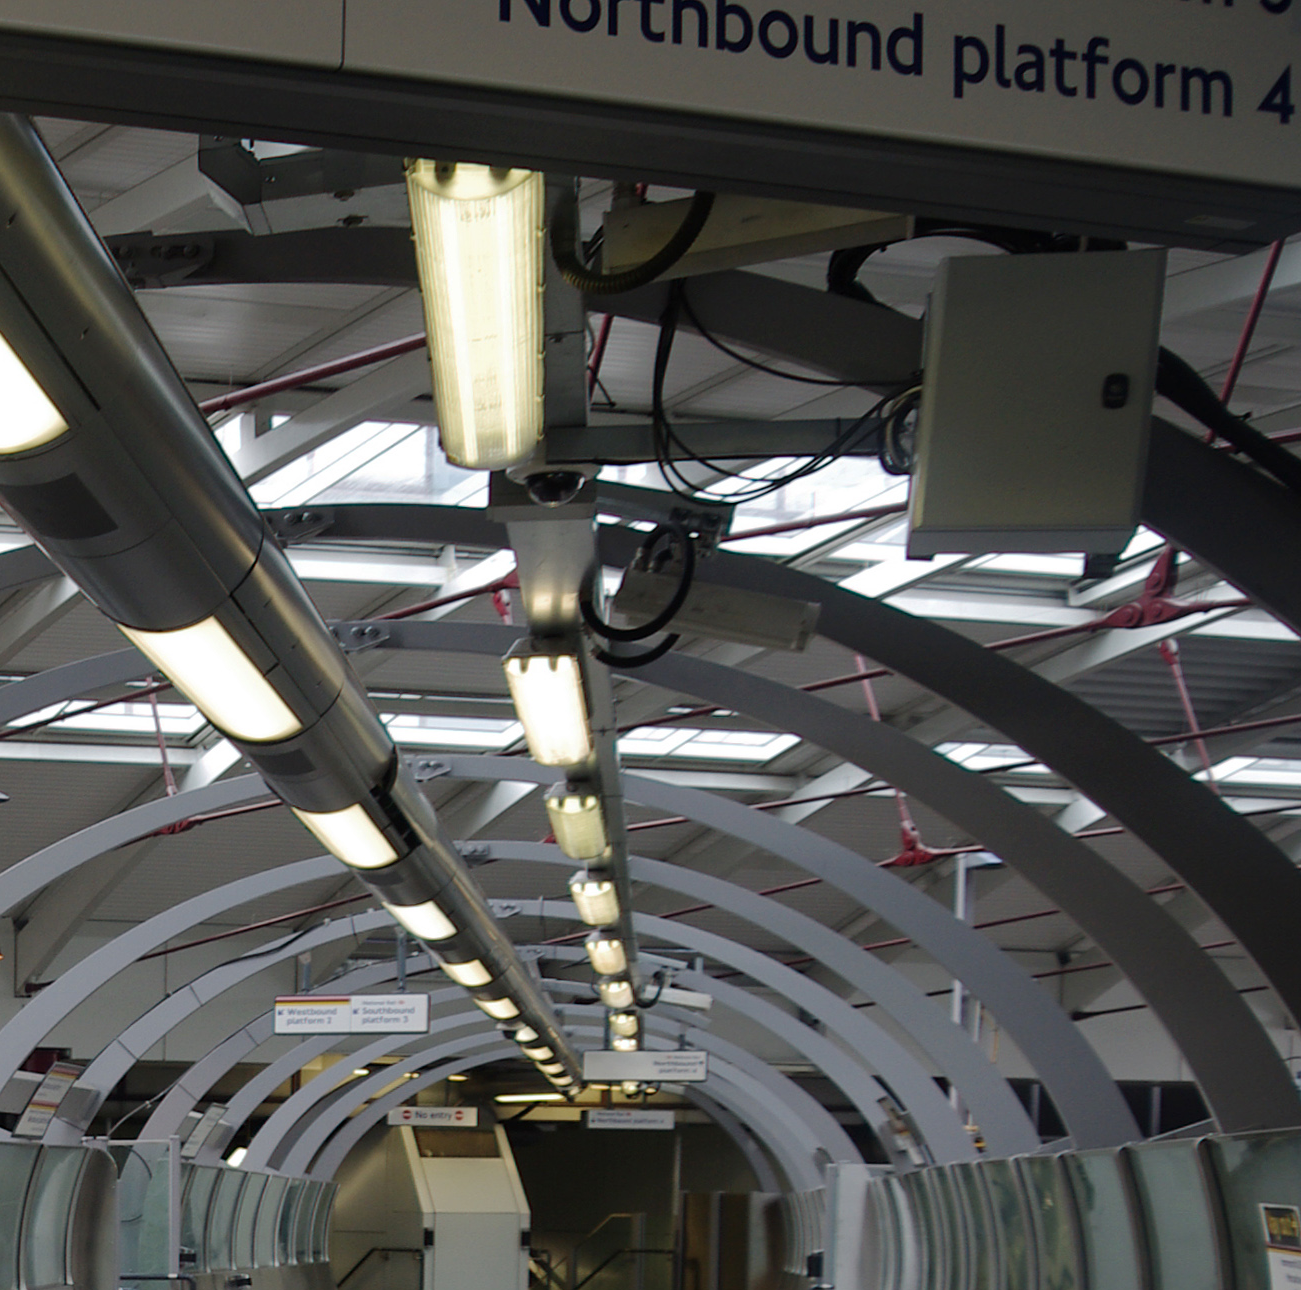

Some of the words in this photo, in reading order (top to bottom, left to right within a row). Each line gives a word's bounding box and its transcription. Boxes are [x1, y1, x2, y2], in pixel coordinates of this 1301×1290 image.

[954, 25, 1233, 117] platform
[1257, 63, 1296, 125] 4
[414, 1110, 430, 1120] No
[431, 1111, 453, 1123] entry
